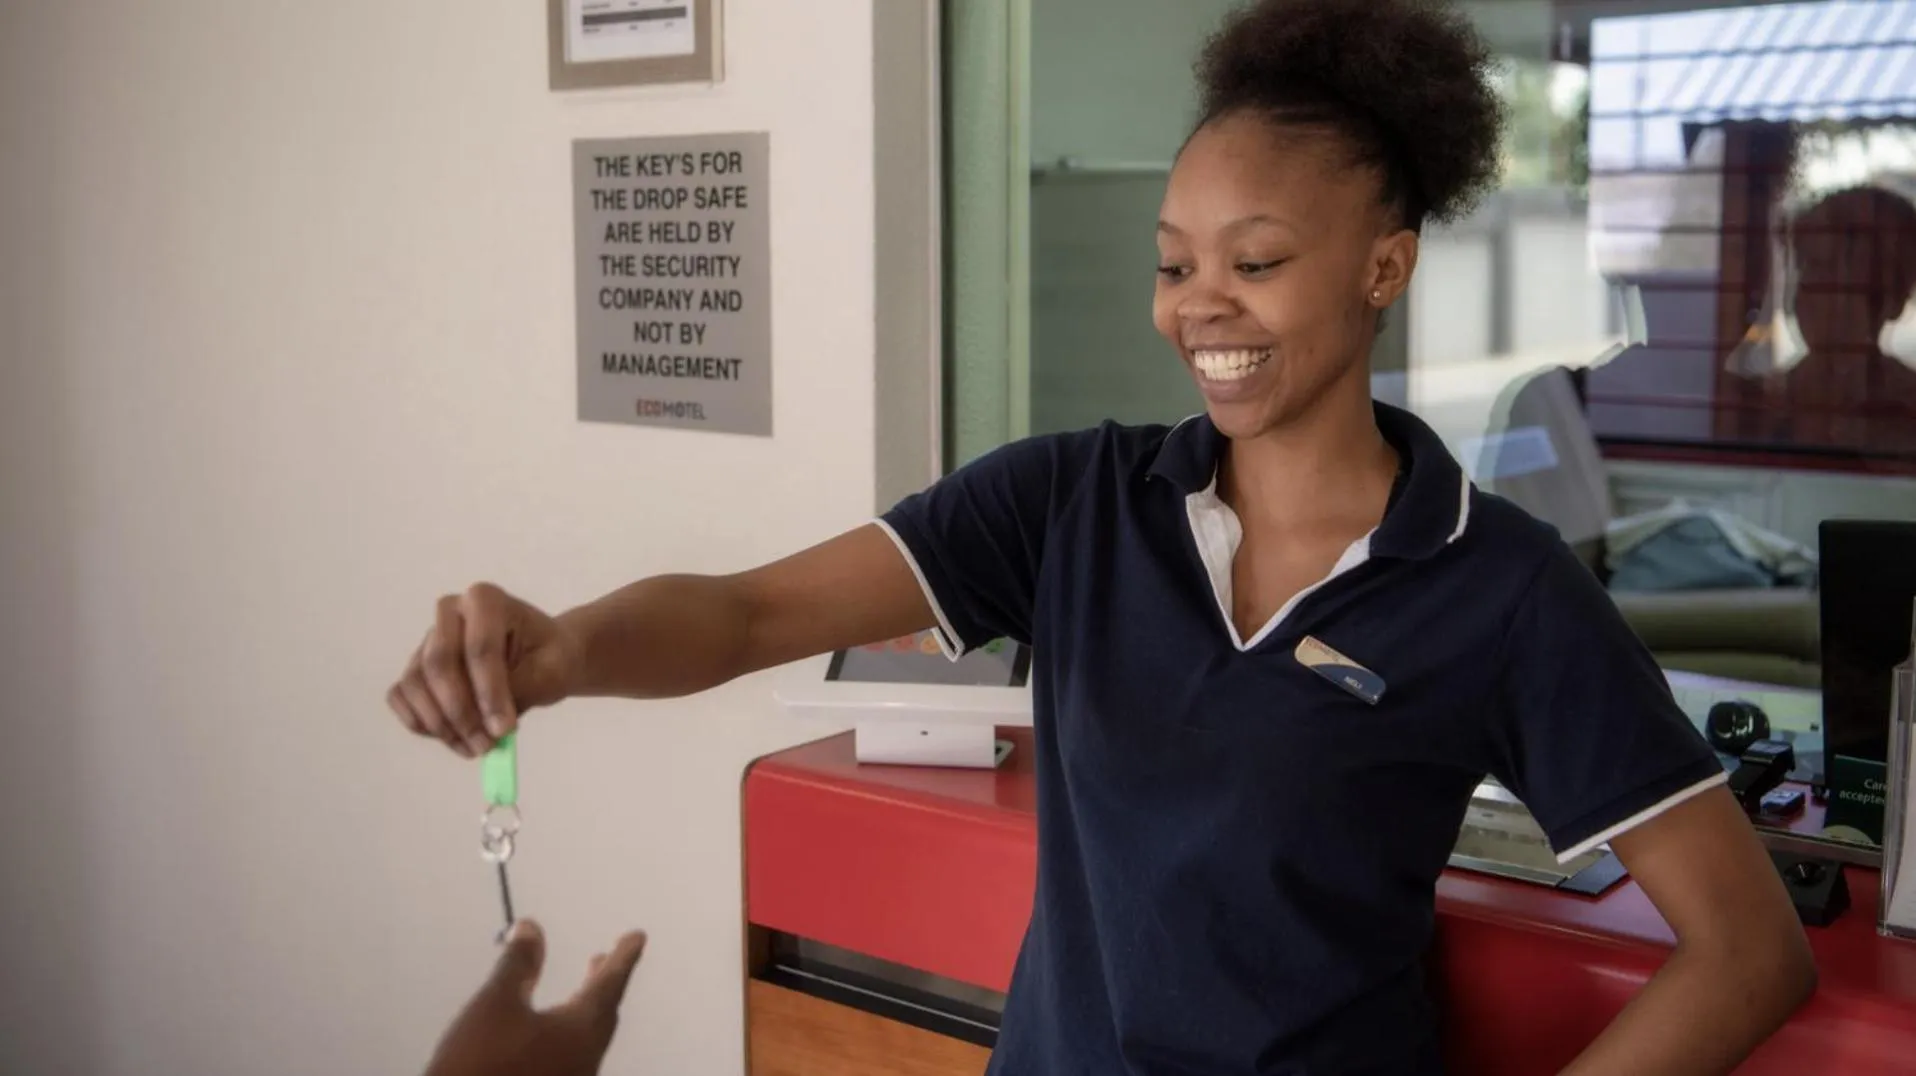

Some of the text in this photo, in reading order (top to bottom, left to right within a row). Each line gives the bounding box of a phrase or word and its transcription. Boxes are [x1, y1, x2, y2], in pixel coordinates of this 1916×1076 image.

[594, 151, 742, 178] THE KEY'S FOR
[591, 186, 748, 210] THE DROP SAFE
[604, 221, 735, 244] ARE HELD BY
[600, 255, 741, 277] THE SECURITY
[599, 287, 742, 313] COMPANY AND
[634, 321, 706, 345] NOT BY
[602, 353, 742, 381] MANAGEMENT
